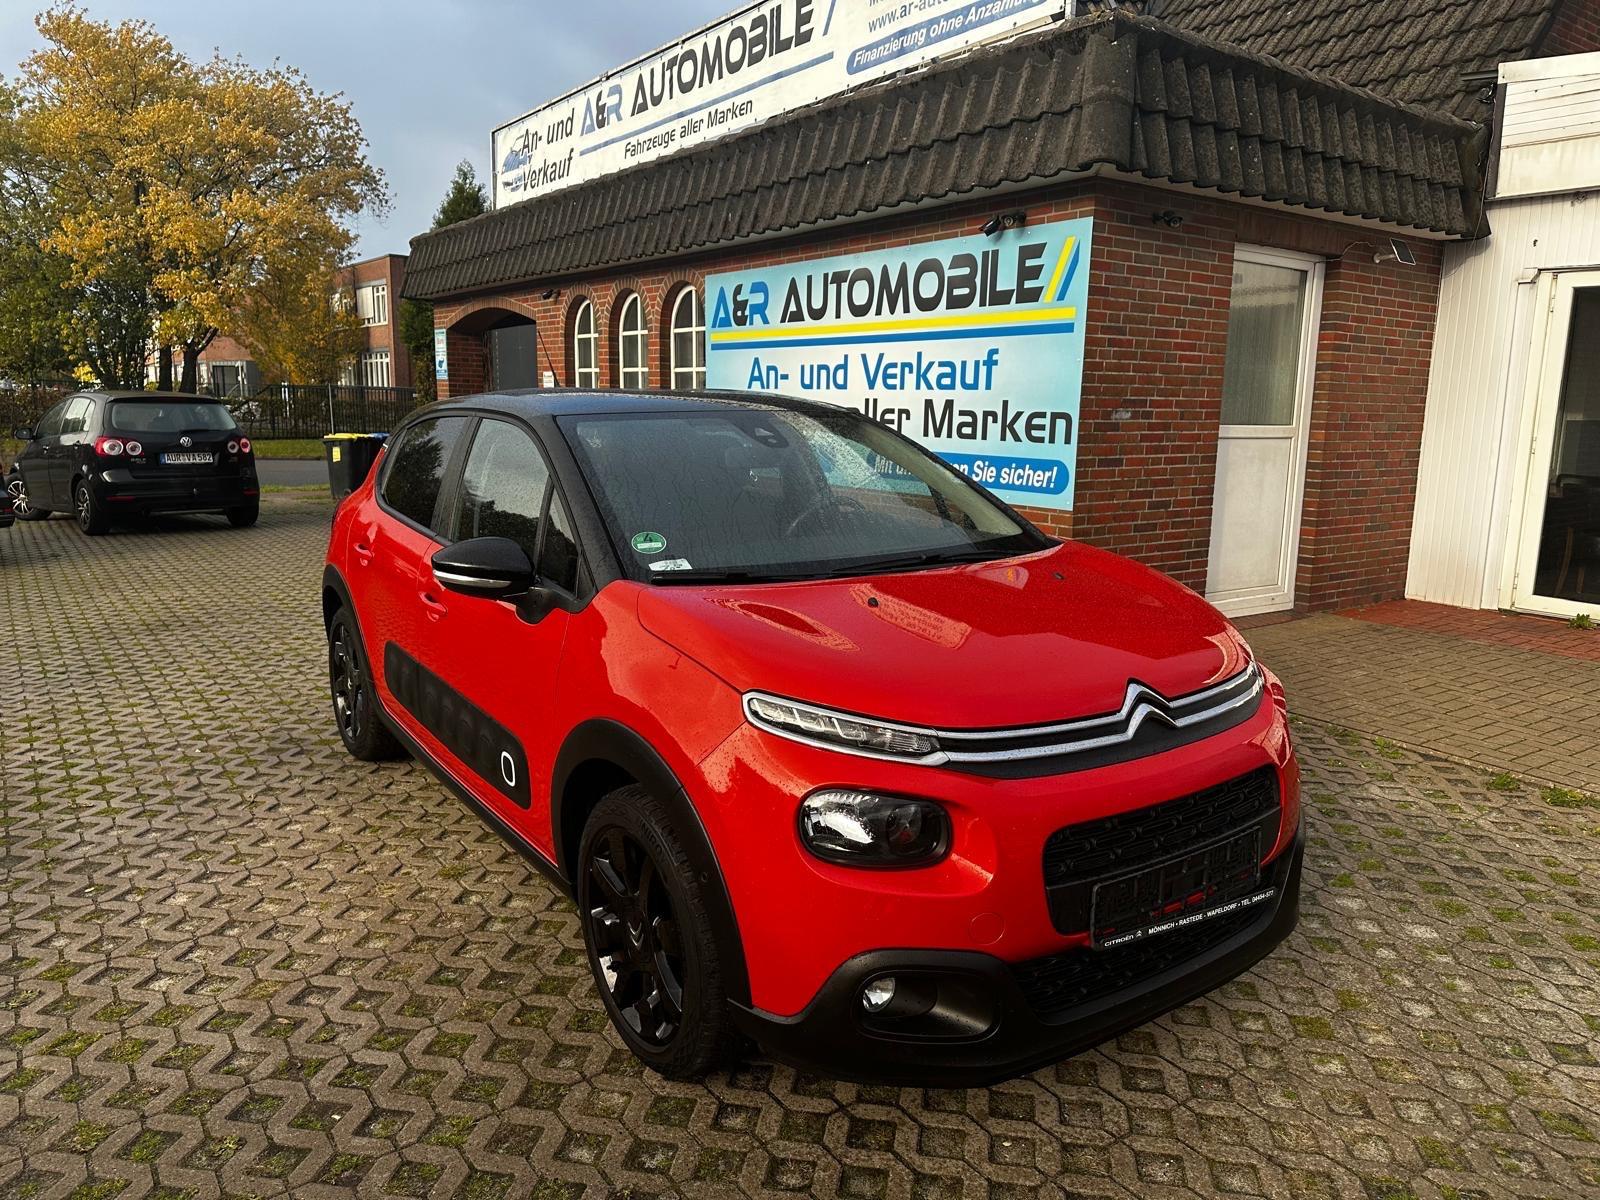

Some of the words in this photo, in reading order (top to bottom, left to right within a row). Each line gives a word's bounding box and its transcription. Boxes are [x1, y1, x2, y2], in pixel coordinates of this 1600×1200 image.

[854, 28, 926, 67] Finanzierung
[929, 17, 963, 37] ohne
[580, 84, 623, 136] A&R
[630, 0, 815, 117] AUTOMOBILE
[520, 128, 542, 156] An-
[546, 108, 575, 145] und
[624, 131, 676, 159] Fahrzeuge
[680, 119, 704, 138] aller
[706, 100, 753, 128] Marken
[521, 148, 574, 192] Verkauf
[711, 281, 770, 328] A&R
[780, 241, 1048, 323] AUTOMOBILE
[748, 356, 789, 390] An-
[800, 354, 849, 390] und
[861, 348, 1000, 391] Verkauf
[849, 398, 911, 434] ller
[922, 399, 1073, 444] Marken
[971, 460, 997, 482] Sie
[999, 463, 1058, 488] sicher!
[1179, 913, 1203, 926] RASTEDE
[1207, 902, 1238, 918] WAPELDORF
